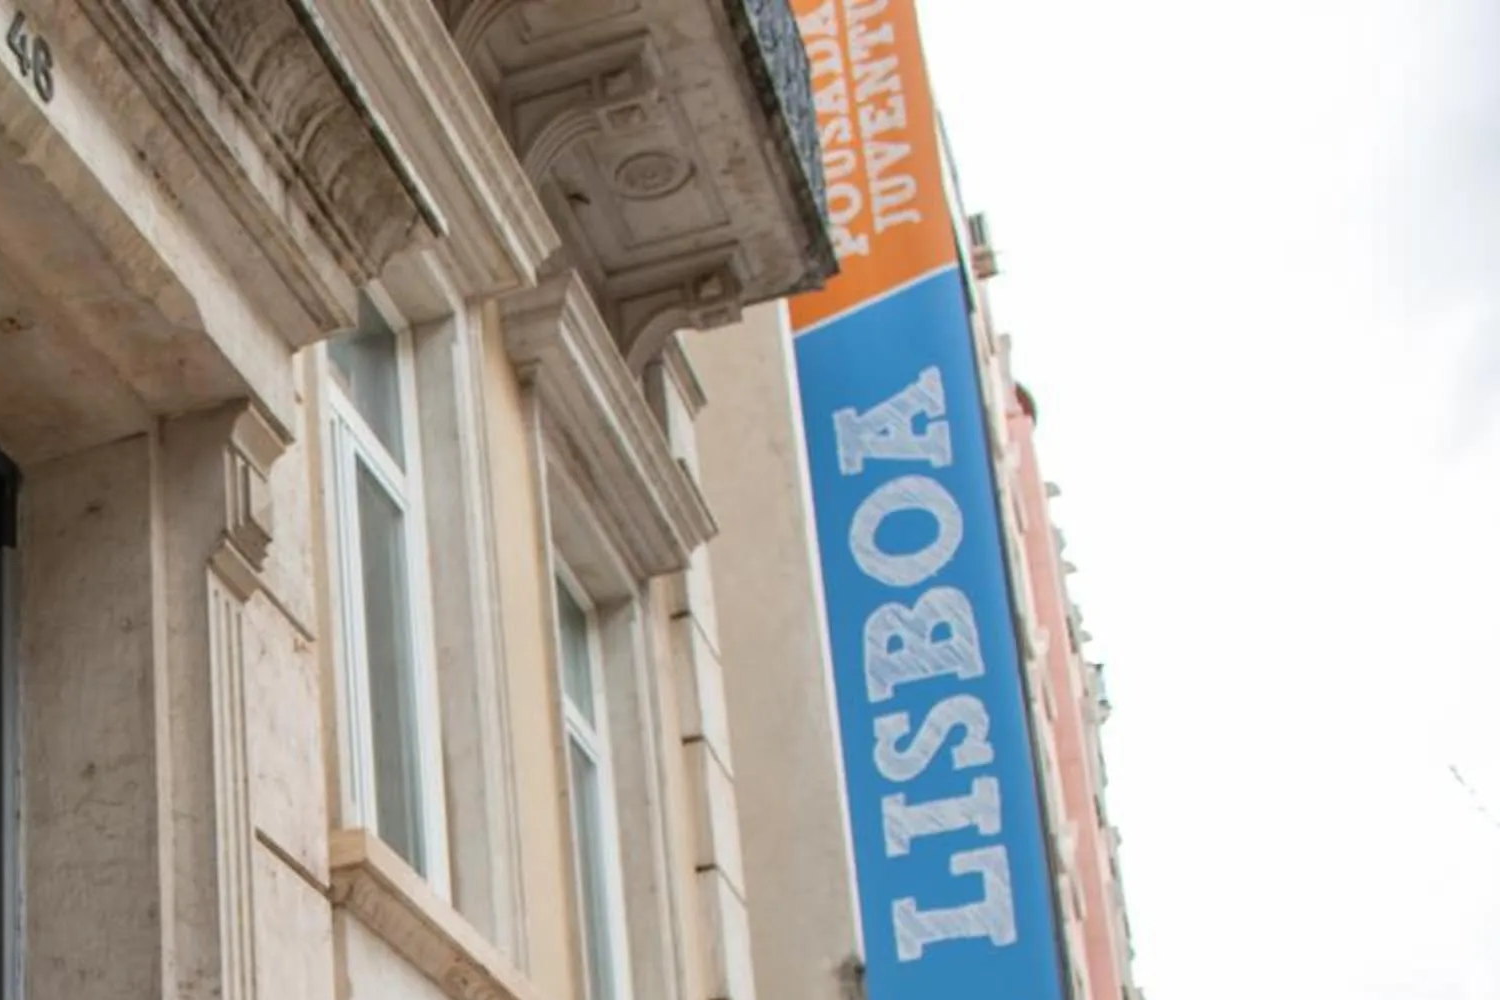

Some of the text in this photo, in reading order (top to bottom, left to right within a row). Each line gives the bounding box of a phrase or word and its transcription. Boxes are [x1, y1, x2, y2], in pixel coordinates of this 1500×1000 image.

[6, 9, 54, 104] 46
[797, 0, 869, 259] POUSADA
[833, 366, 1017, 961] LISBOA
